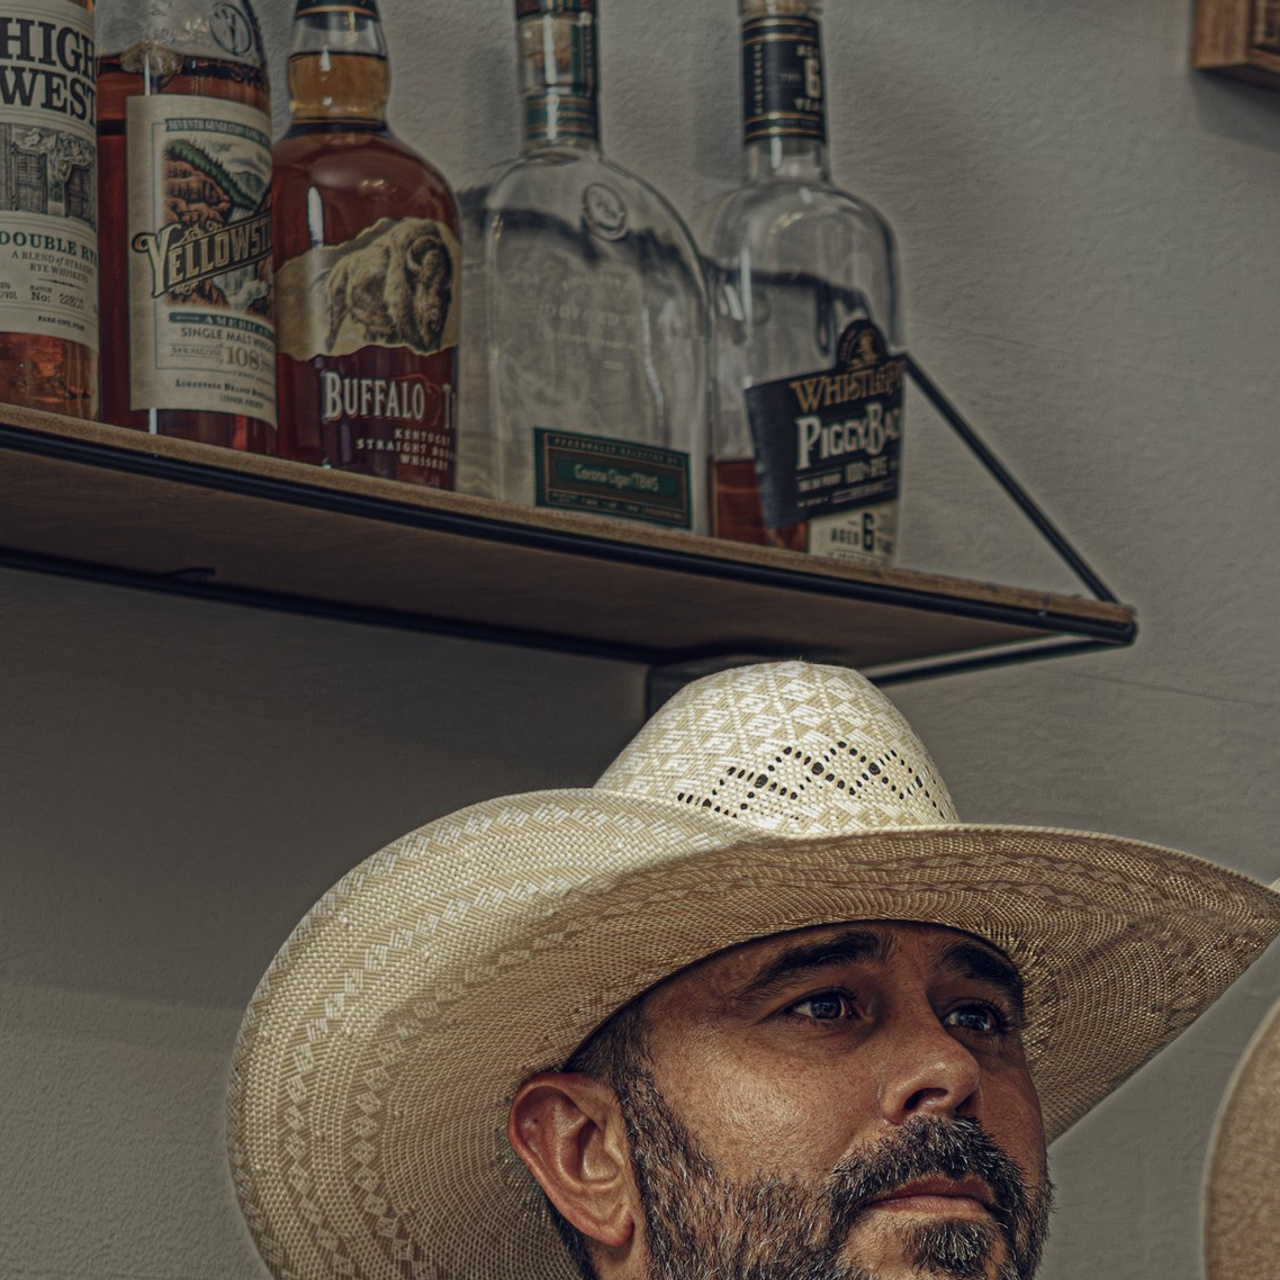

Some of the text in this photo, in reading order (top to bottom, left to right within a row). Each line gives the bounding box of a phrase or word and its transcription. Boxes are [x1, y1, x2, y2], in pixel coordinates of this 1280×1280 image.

[0, 231, 77, 256] DOUBLE
[22, 252, 55, 263] BLEND
[30, 263, 49, 273] RYE
[181, 327, 223, 339] SINGLE
[226, 331, 252, 345] MALT
[226, 346, 260, 371] 108
[325, 371, 425, 421] BUFFALO
[356, 438, 427, 454] STRAIGHT
[863, 512, 875, 551] 6
